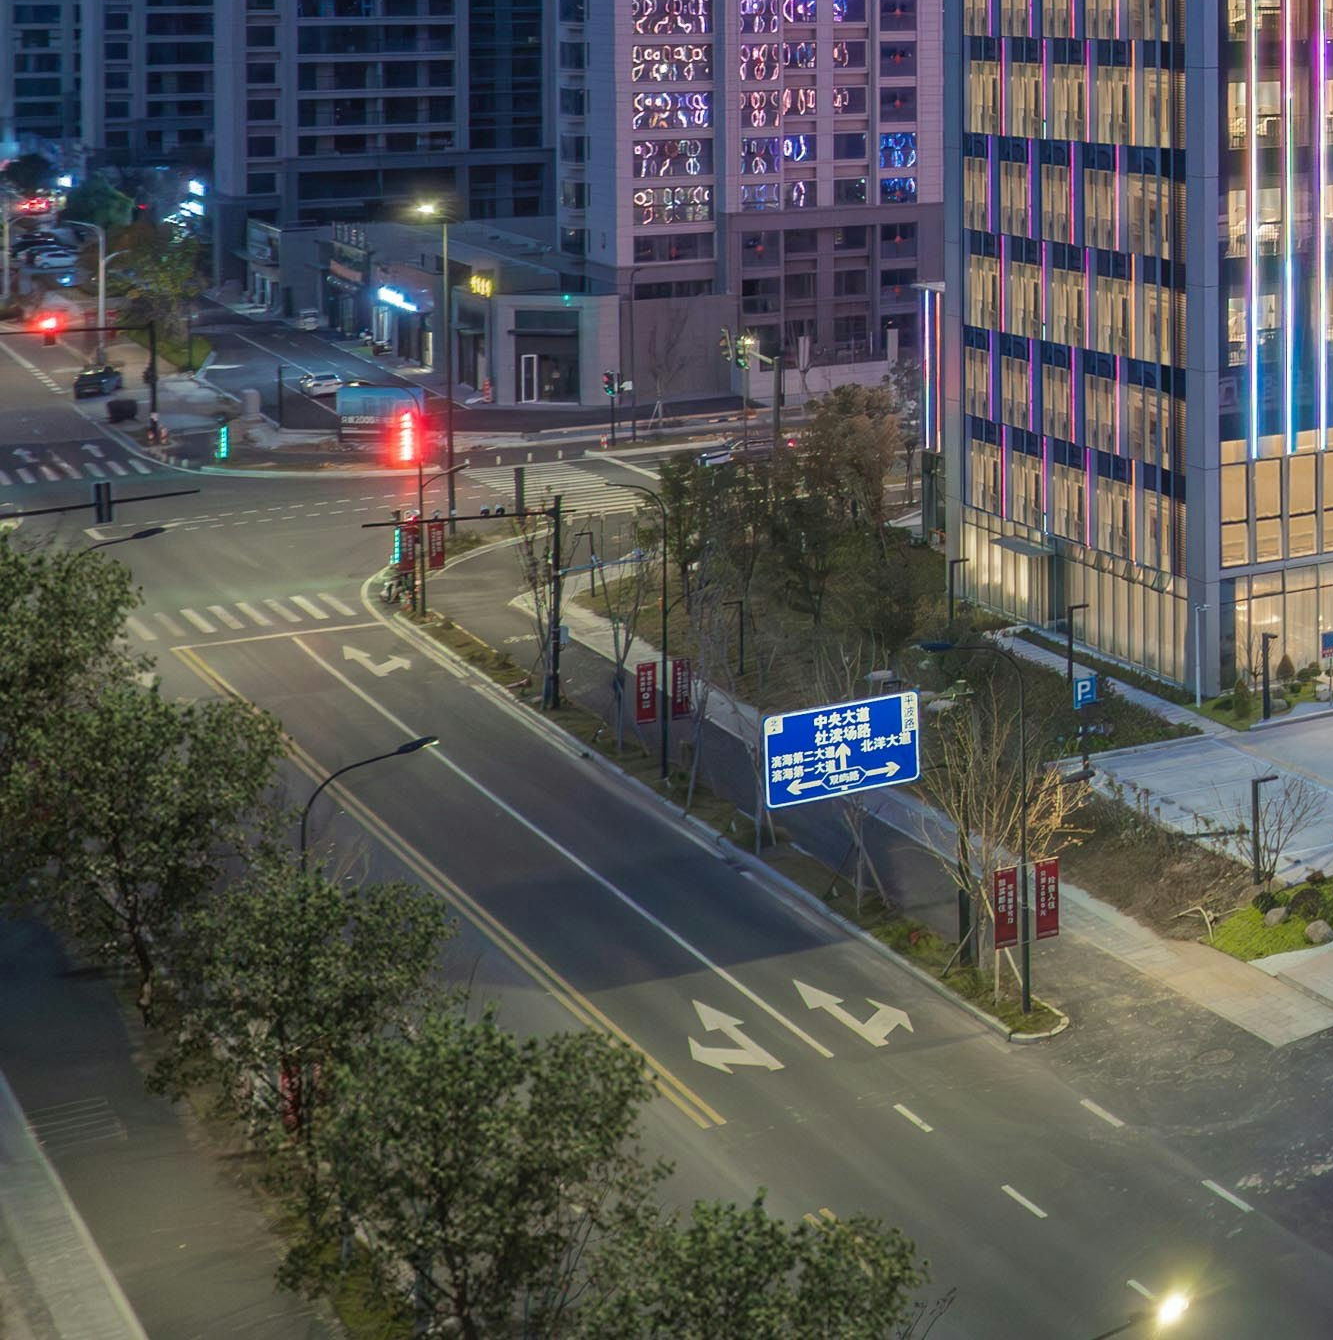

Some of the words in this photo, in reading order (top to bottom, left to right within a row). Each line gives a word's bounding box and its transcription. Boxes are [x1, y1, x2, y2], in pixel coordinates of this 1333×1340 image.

[1077, 680, 1091, 701] P
[813, 706, 870, 729] 中央大道
[860, 732, 912, 753] 北洋大道
